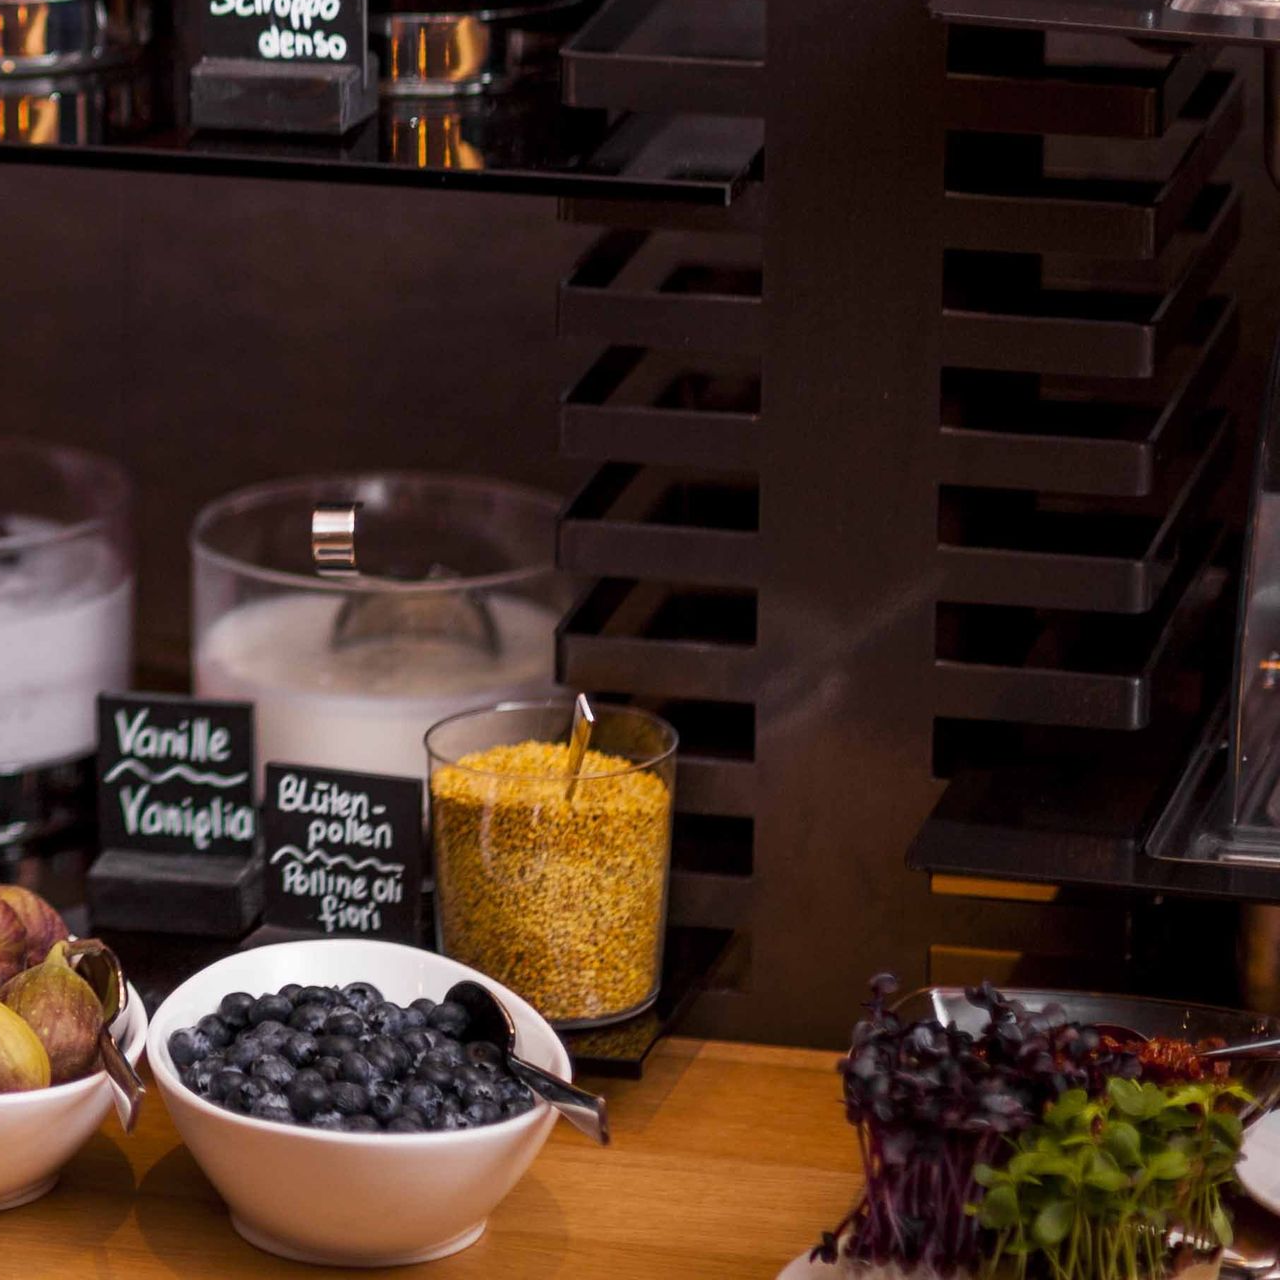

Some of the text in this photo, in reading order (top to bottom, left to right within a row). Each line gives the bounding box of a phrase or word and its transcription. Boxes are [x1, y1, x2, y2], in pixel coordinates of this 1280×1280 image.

[258, 24, 347, 60] denso
[115, 708, 232, 762] Vanille
[278, 774, 386, 820] Blüten-
[119, 784, 255, 850] Vaniglia
[308, 818, 392, 850] pollen
[283, 861, 369, 899] Polline
[318, 895, 381, 932] fiori
